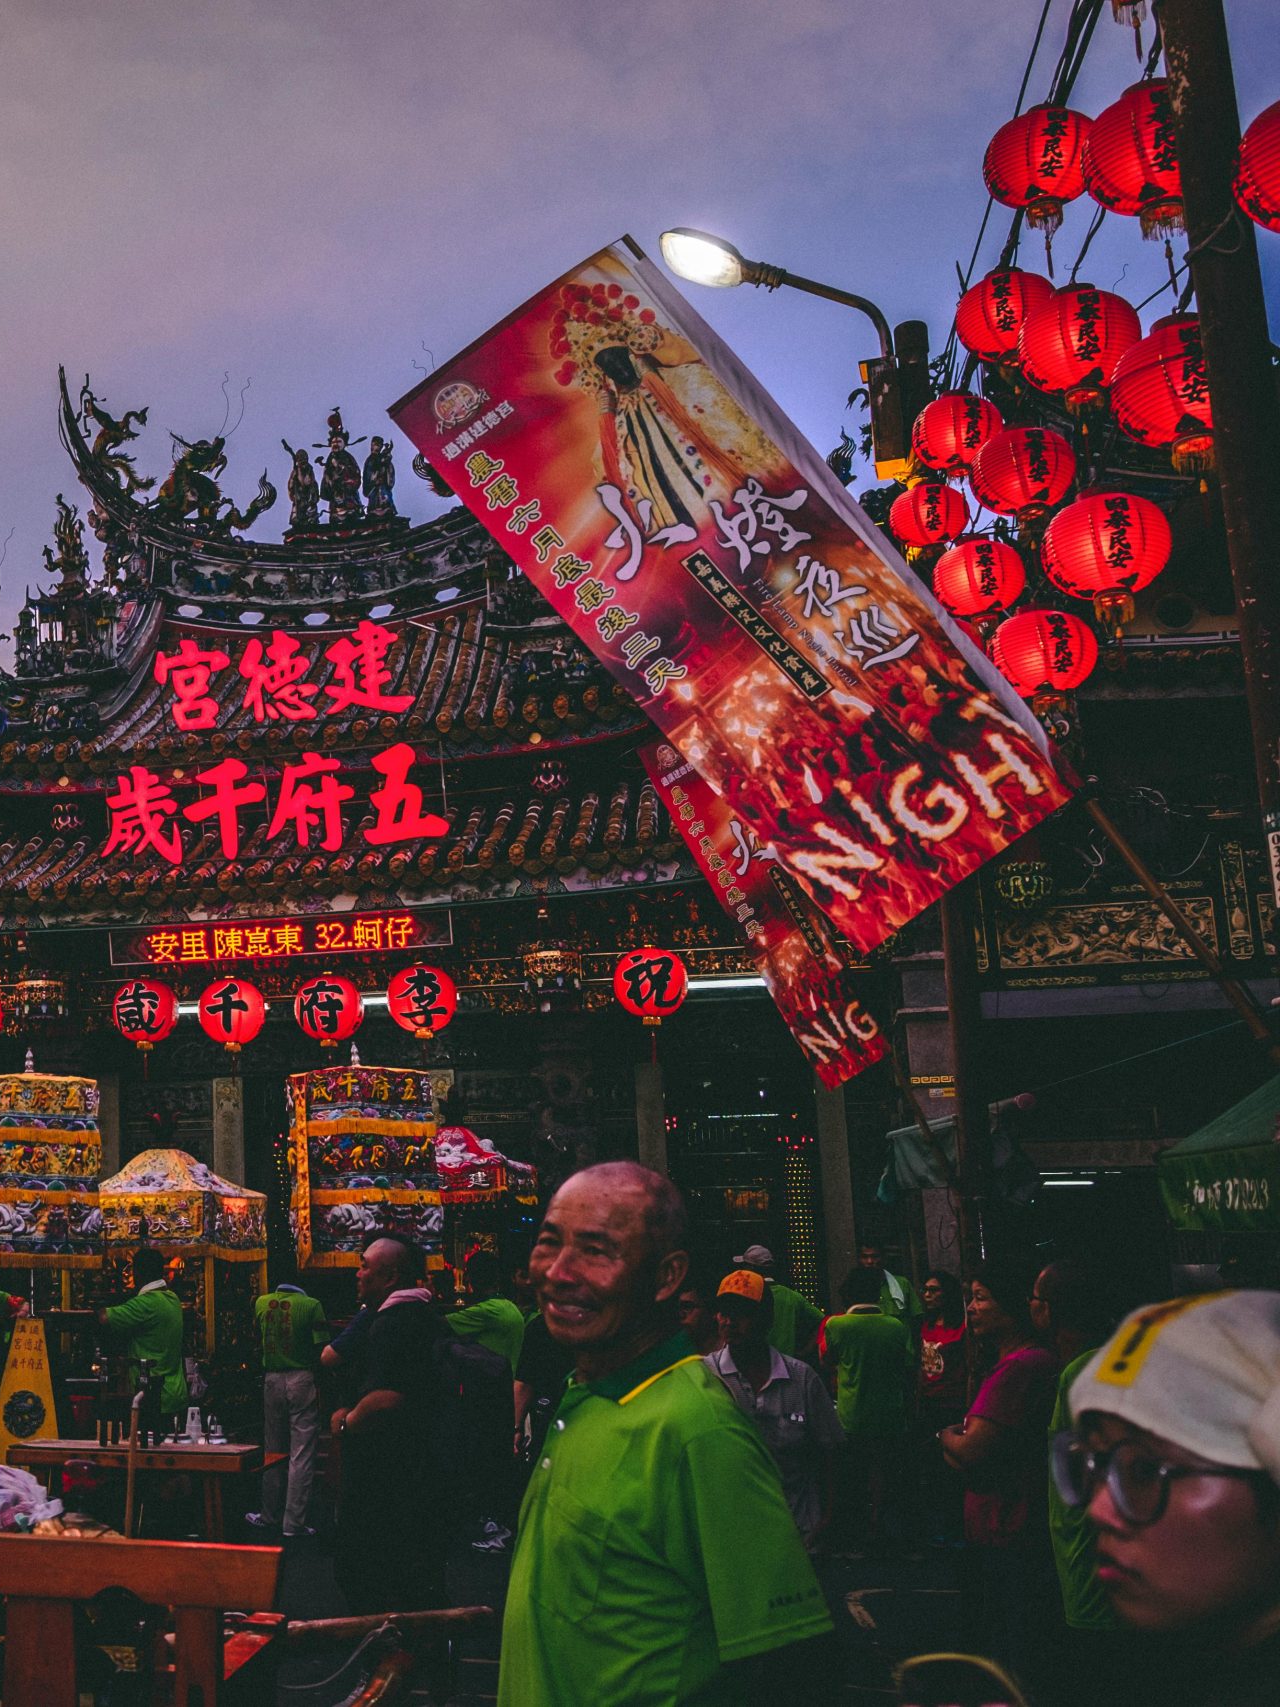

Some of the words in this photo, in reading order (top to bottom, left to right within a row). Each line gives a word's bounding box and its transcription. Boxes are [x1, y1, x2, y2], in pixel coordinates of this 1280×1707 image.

[154, 619, 416, 731] 建德宮
[752, 577, 776, 601] Fire
[771, 600, 801, 630] Lamp
[825, 655, 858, 688] Patrol
[101, 742, 450, 865] 五府千歲
[151, 930, 209, 961] 安里
[214, 924, 304, 958] 陳崑東
[623, 954, 675, 1008] 祝
